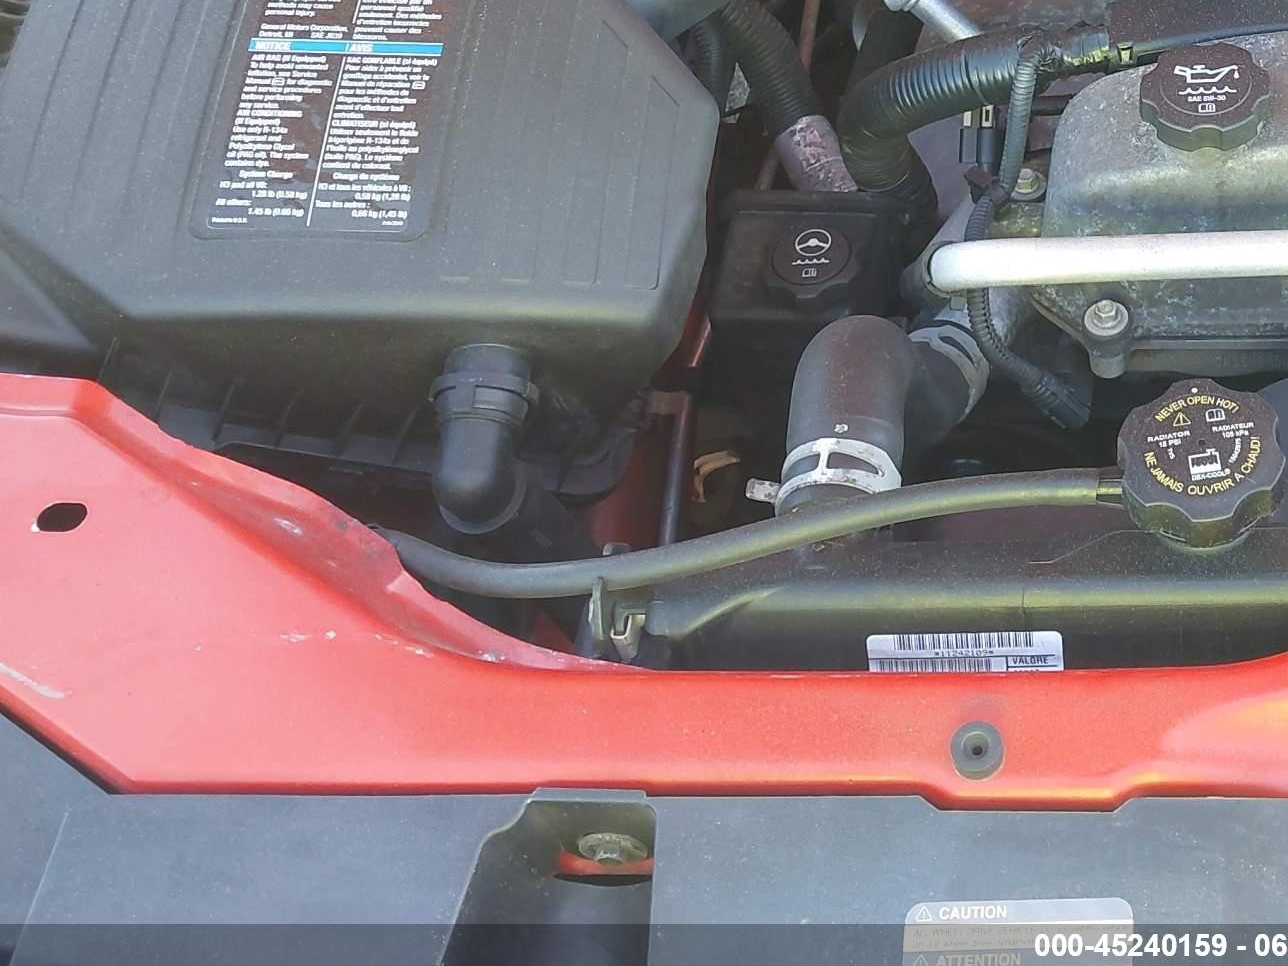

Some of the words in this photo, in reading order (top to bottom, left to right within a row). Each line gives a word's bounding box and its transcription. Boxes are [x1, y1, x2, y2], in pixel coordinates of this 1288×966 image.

[349, 43, 373, 52] AVIS
[1203, 94, 1226, 102] 5W-30
[1155, 399, 1186, 422] NEVER
[1187, 395, 1215, 406] OPEN
[1215, 398, 1239, 413] HOT!
[1211, 422, 1254, 433] RADIATEUR
[1147, 430, 1191, 443] RADIATOR
[1168, 438, 1182, 446] PSI
[1144, 451, 1157, 468] NE
[1240, 436, 1261, 474] CHAUD!
[1150, 465, 1184, 493] JAMAIS
[1187, 479, 1235, 495] OUVRIR
[939, 905, 1008, 921] CAUTION
[936, 953, 1022, 966] ATTENTION
